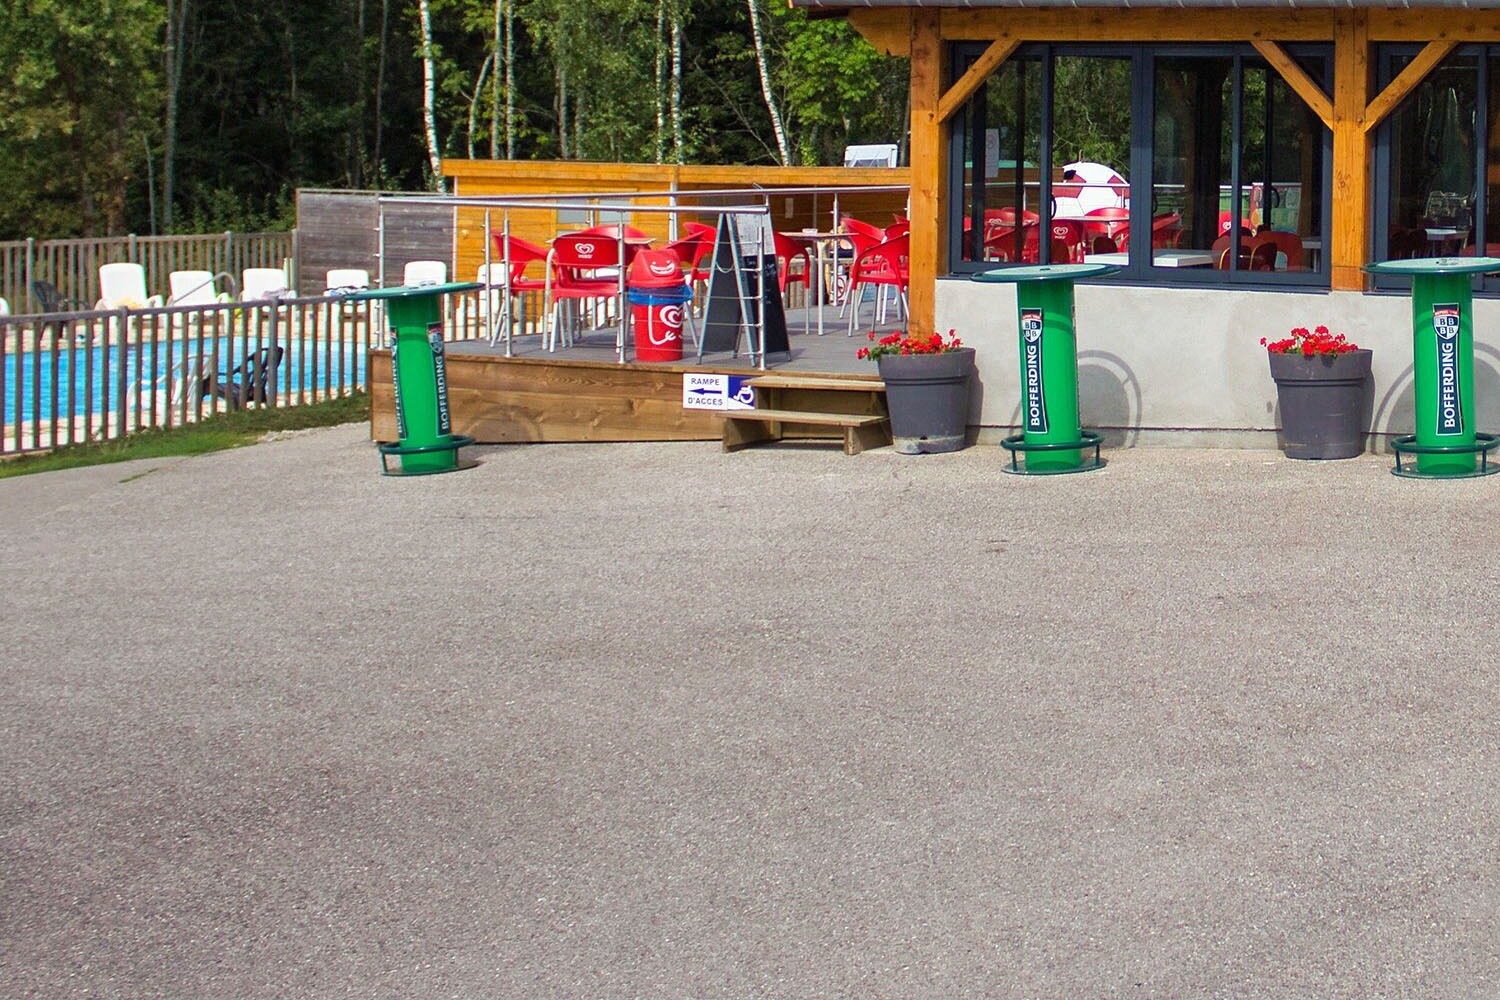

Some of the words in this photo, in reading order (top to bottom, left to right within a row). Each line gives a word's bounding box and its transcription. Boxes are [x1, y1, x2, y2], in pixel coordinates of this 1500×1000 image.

[435, 356, 449, 430] BOFFERDING
[687, 397, 724, 406] D'ACCES
[690, 377, 720, 386] RAMPE
[1027, 345, 1040, 426] BOFFERDING
[1442, 342, 1456, 428] BOFFERDING
